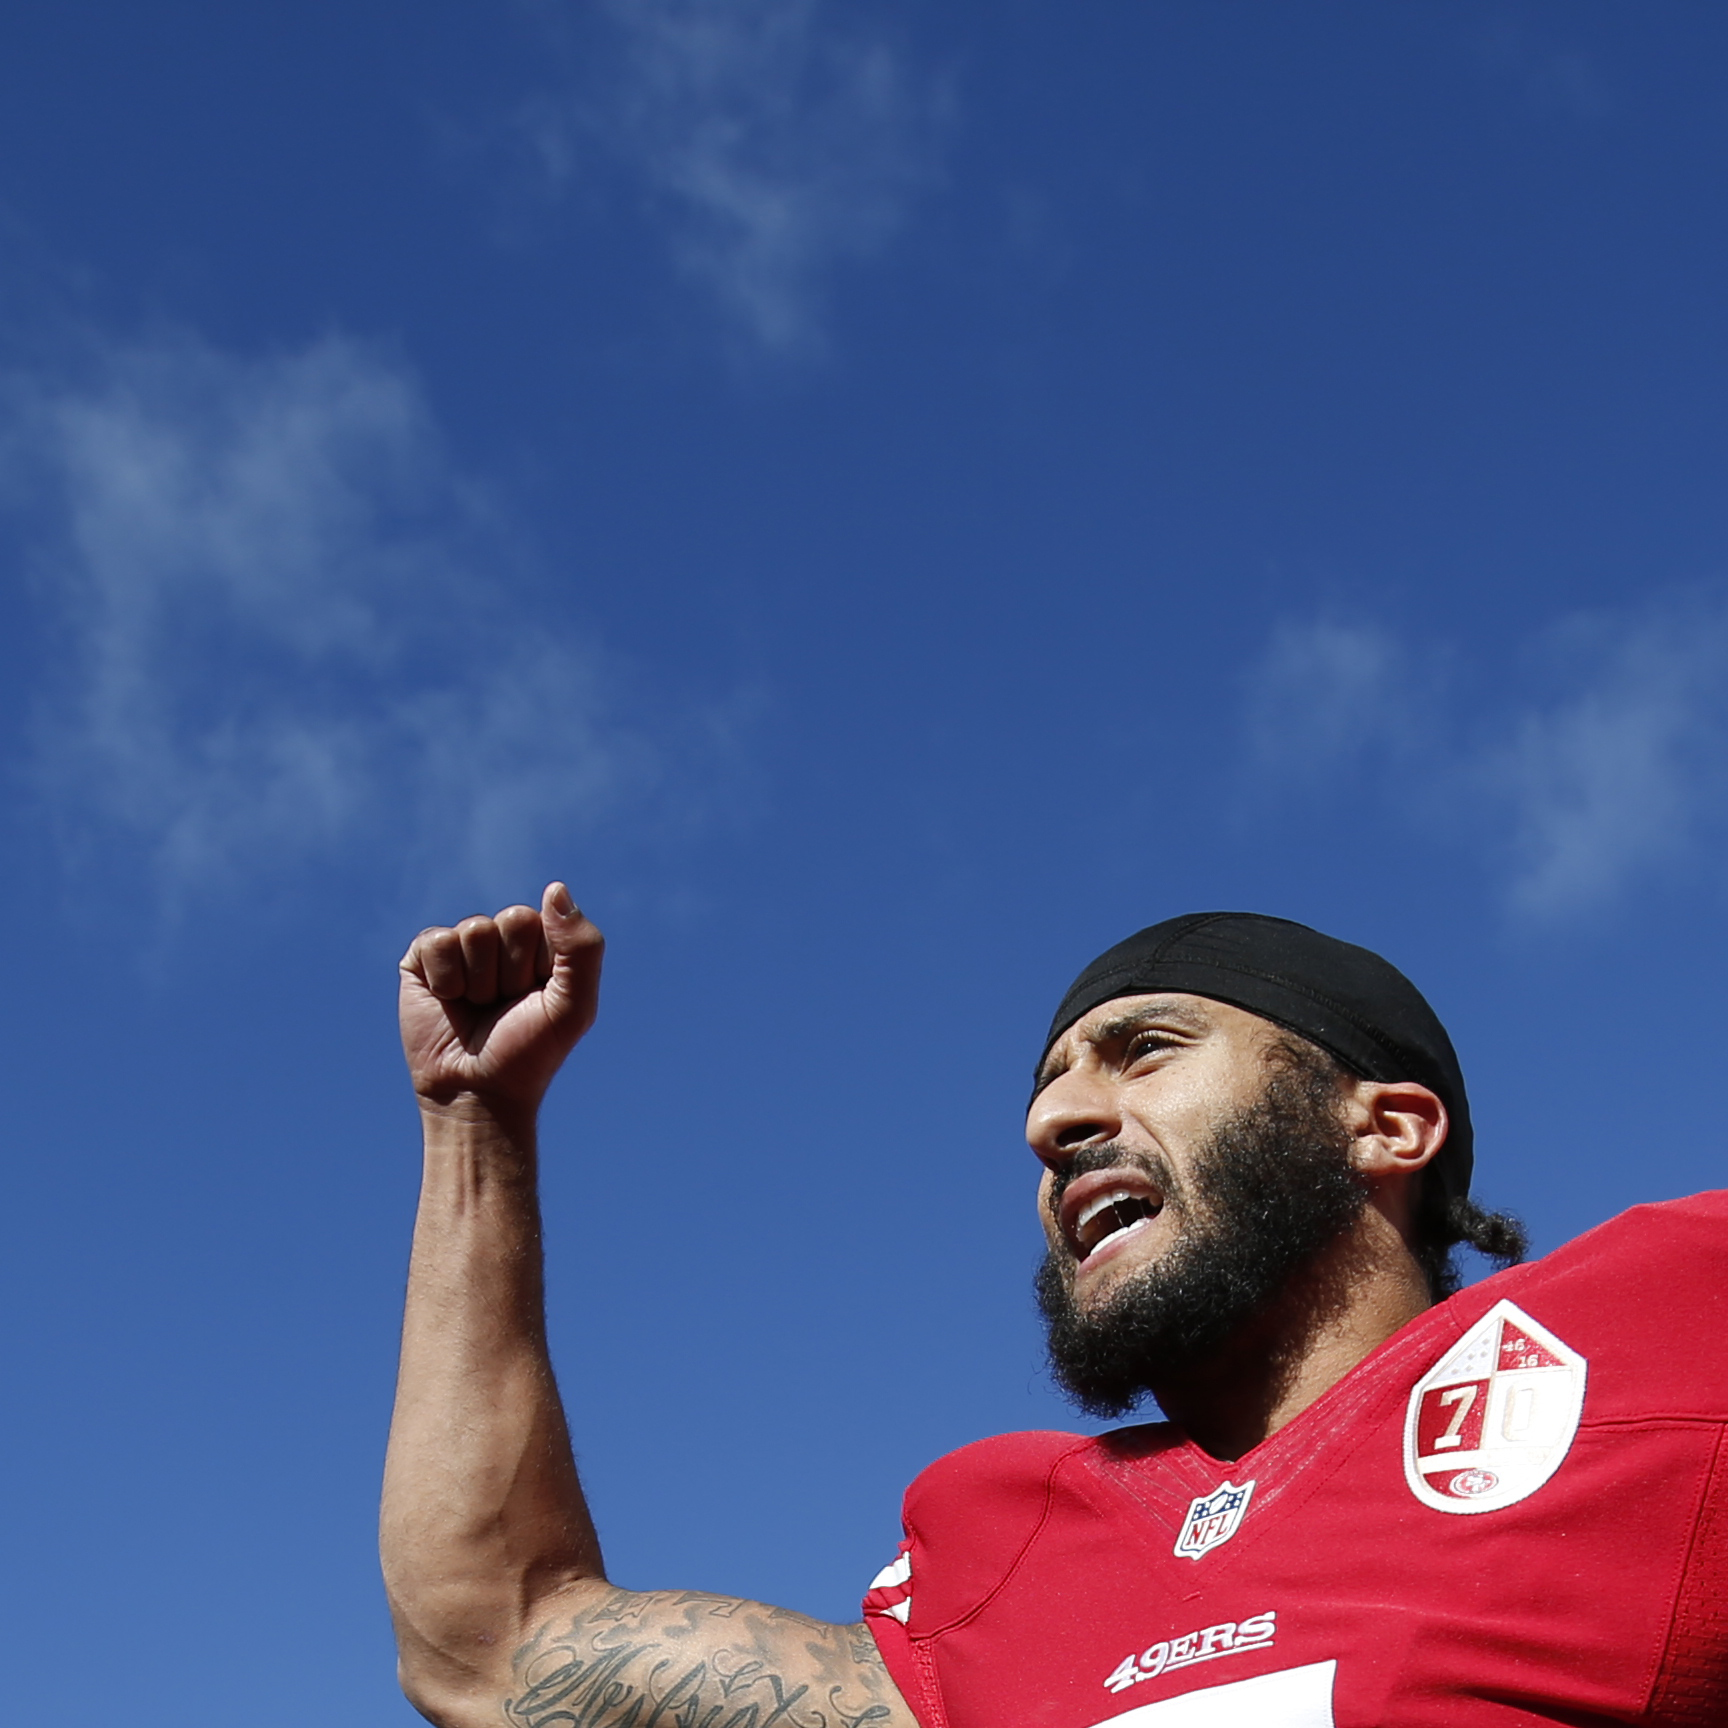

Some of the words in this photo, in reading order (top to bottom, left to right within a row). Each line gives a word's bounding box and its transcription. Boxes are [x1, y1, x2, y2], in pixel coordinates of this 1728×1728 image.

[1518, 1354, 1540, 1368] 16
[1185, 1513, 1229, 1548] NFL
[1103, 1610, 1277, 1694] 49ERS
